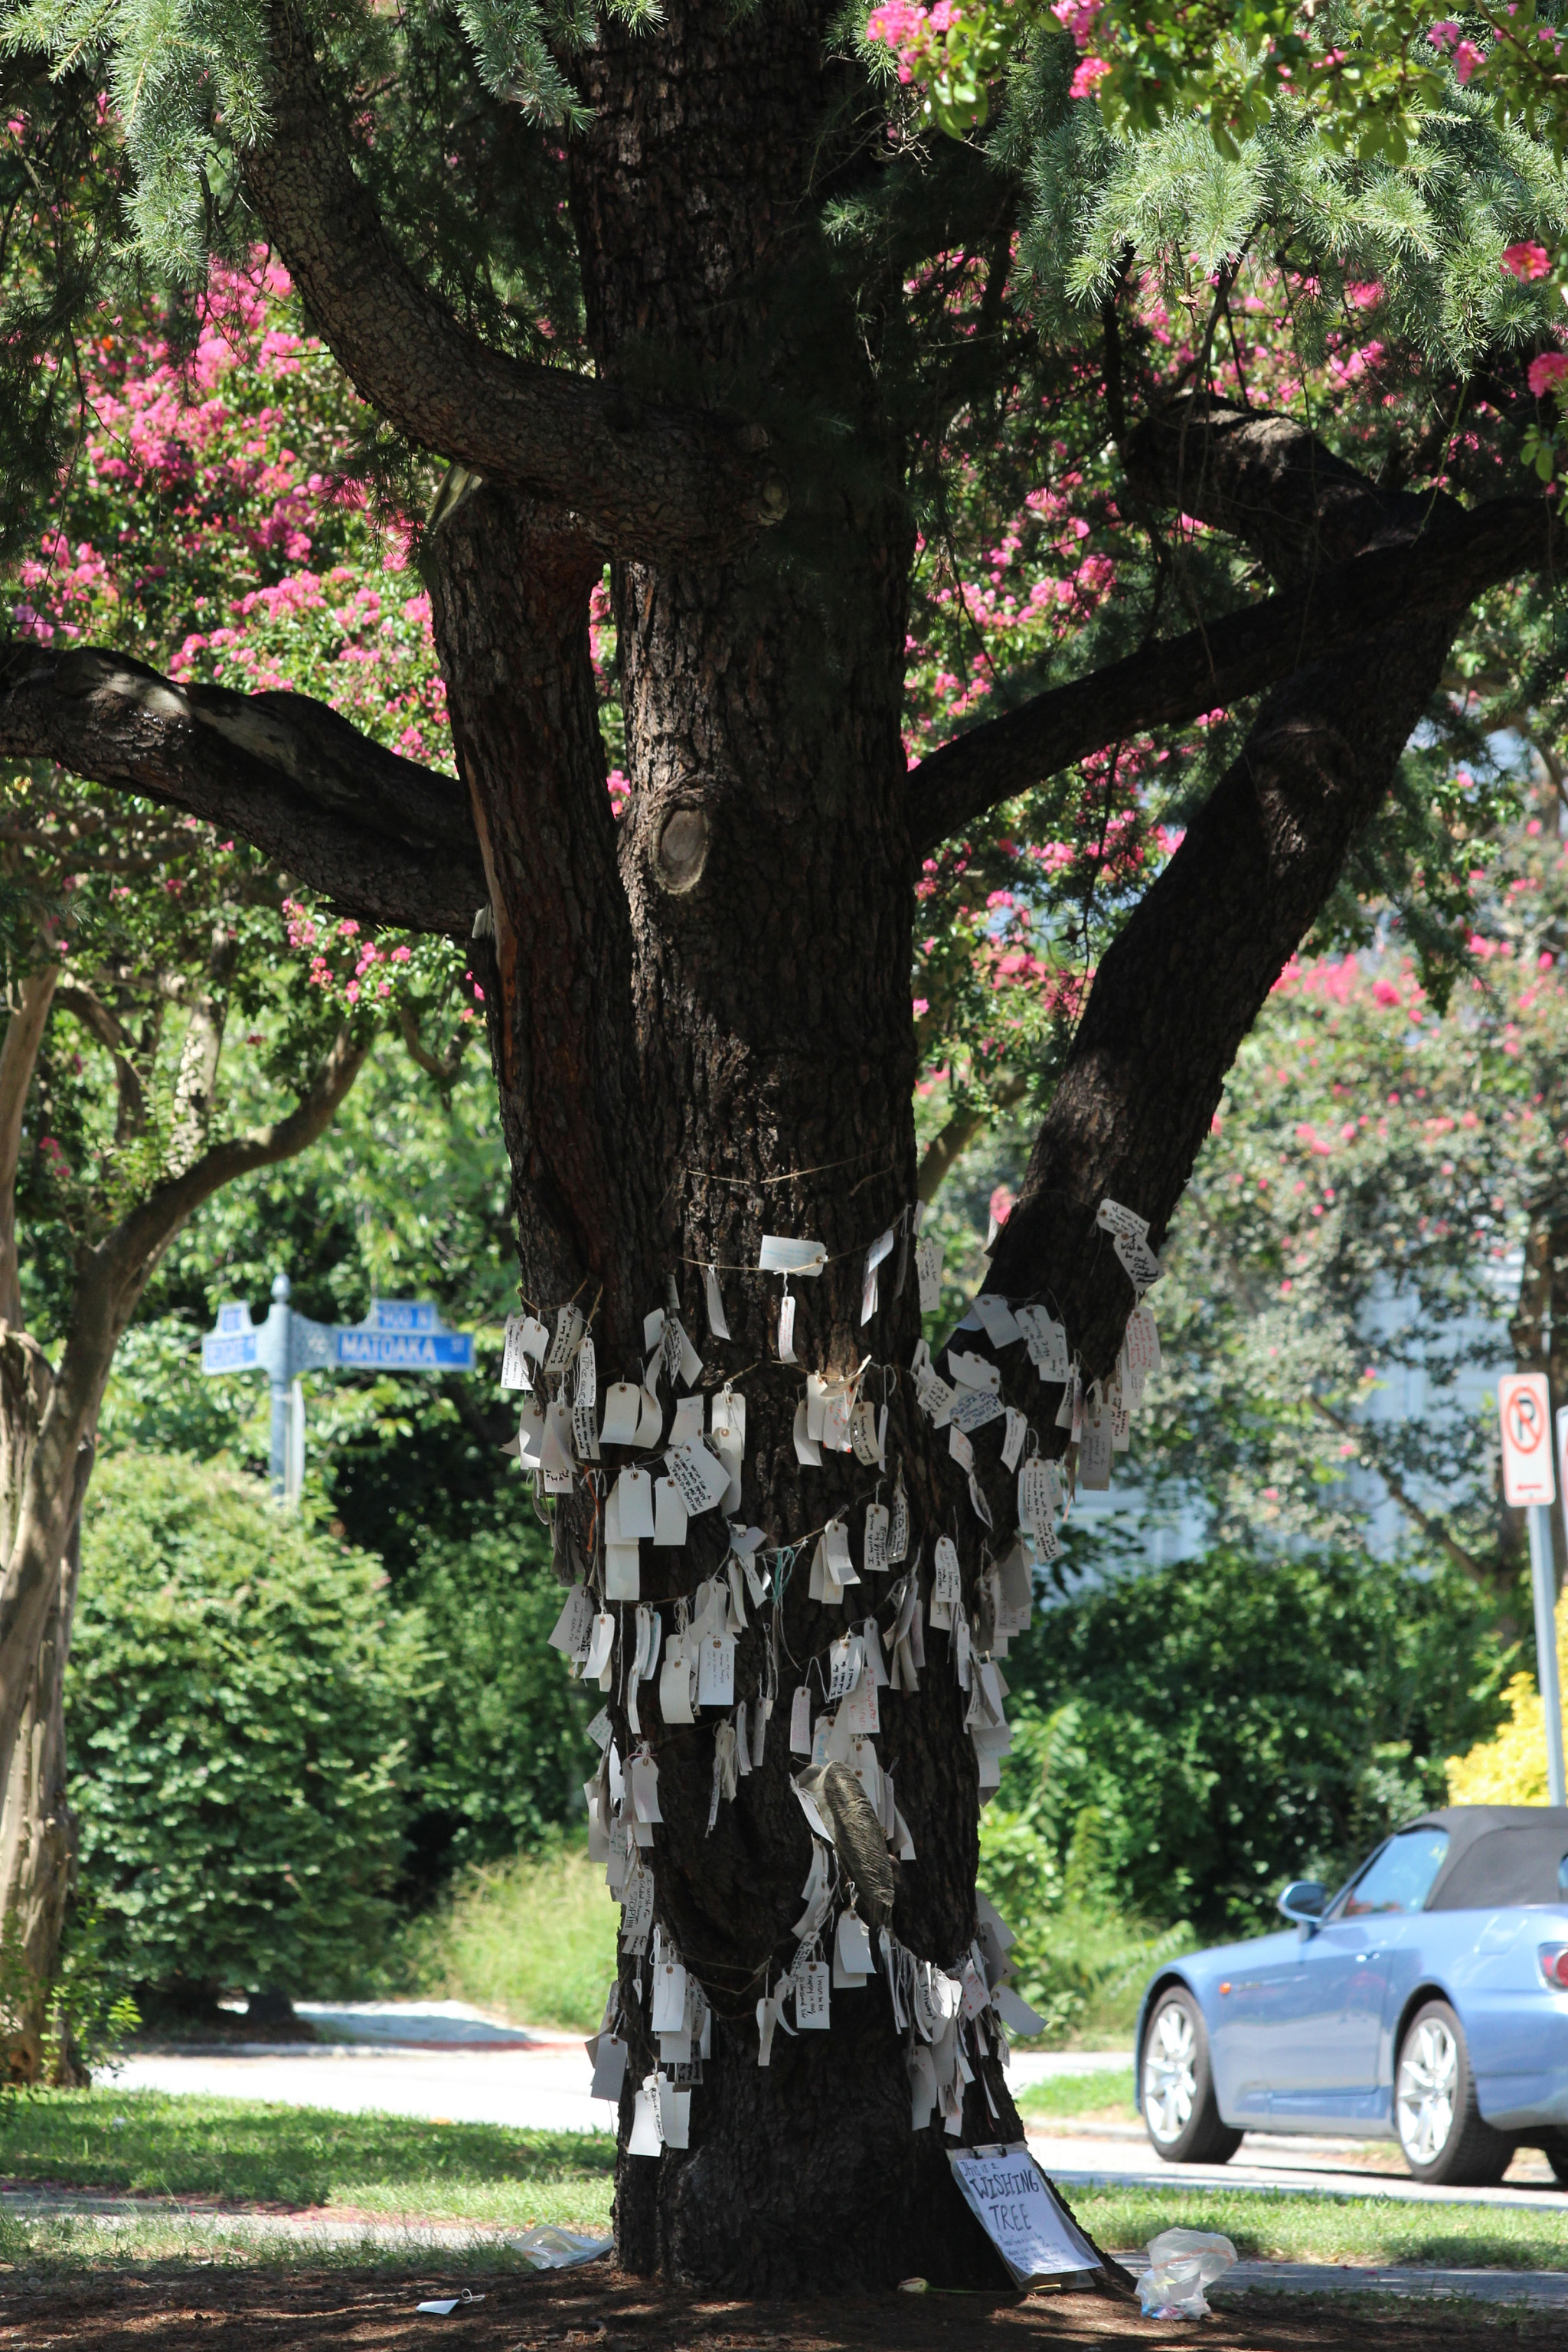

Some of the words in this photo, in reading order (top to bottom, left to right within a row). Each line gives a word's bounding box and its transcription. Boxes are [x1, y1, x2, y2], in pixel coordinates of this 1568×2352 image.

[341, 1332, 437, 1363] MATOAKA
[647, 1877, 652, 1885] I
[960, 2161, 982, 2176] This
[982, 2164, 988, 2174] is
[969, 2169, 1039, 2200] WISHING
[988, 2203, 1031, 2231] TREE
